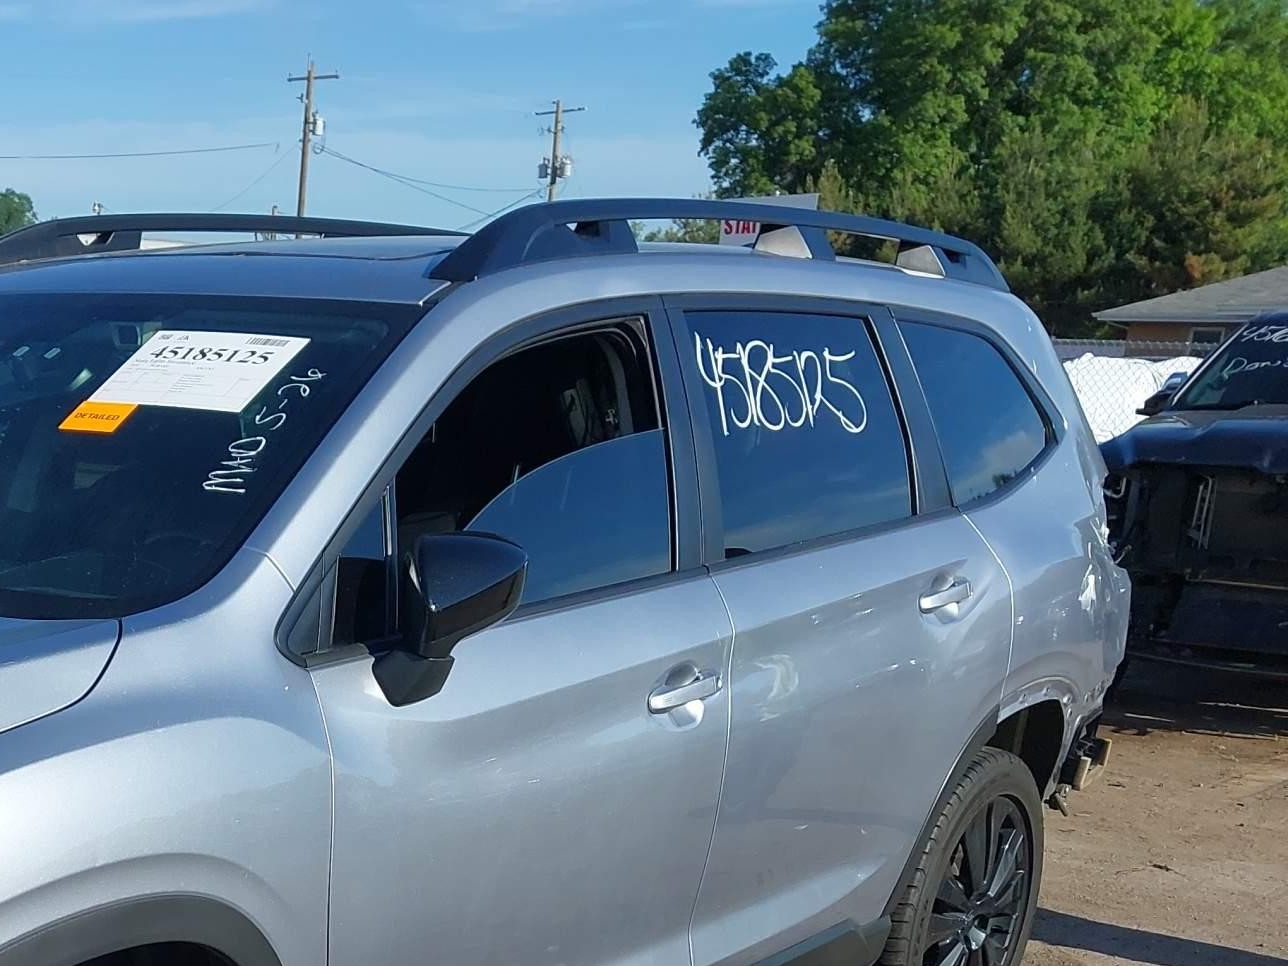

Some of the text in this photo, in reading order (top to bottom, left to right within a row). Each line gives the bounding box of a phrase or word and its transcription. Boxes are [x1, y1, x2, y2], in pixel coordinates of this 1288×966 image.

[150, 346, 275, 364] 45185125
[694, 331, 868, 436] 45185125
[74, 412, 120, 421] DETAILED
